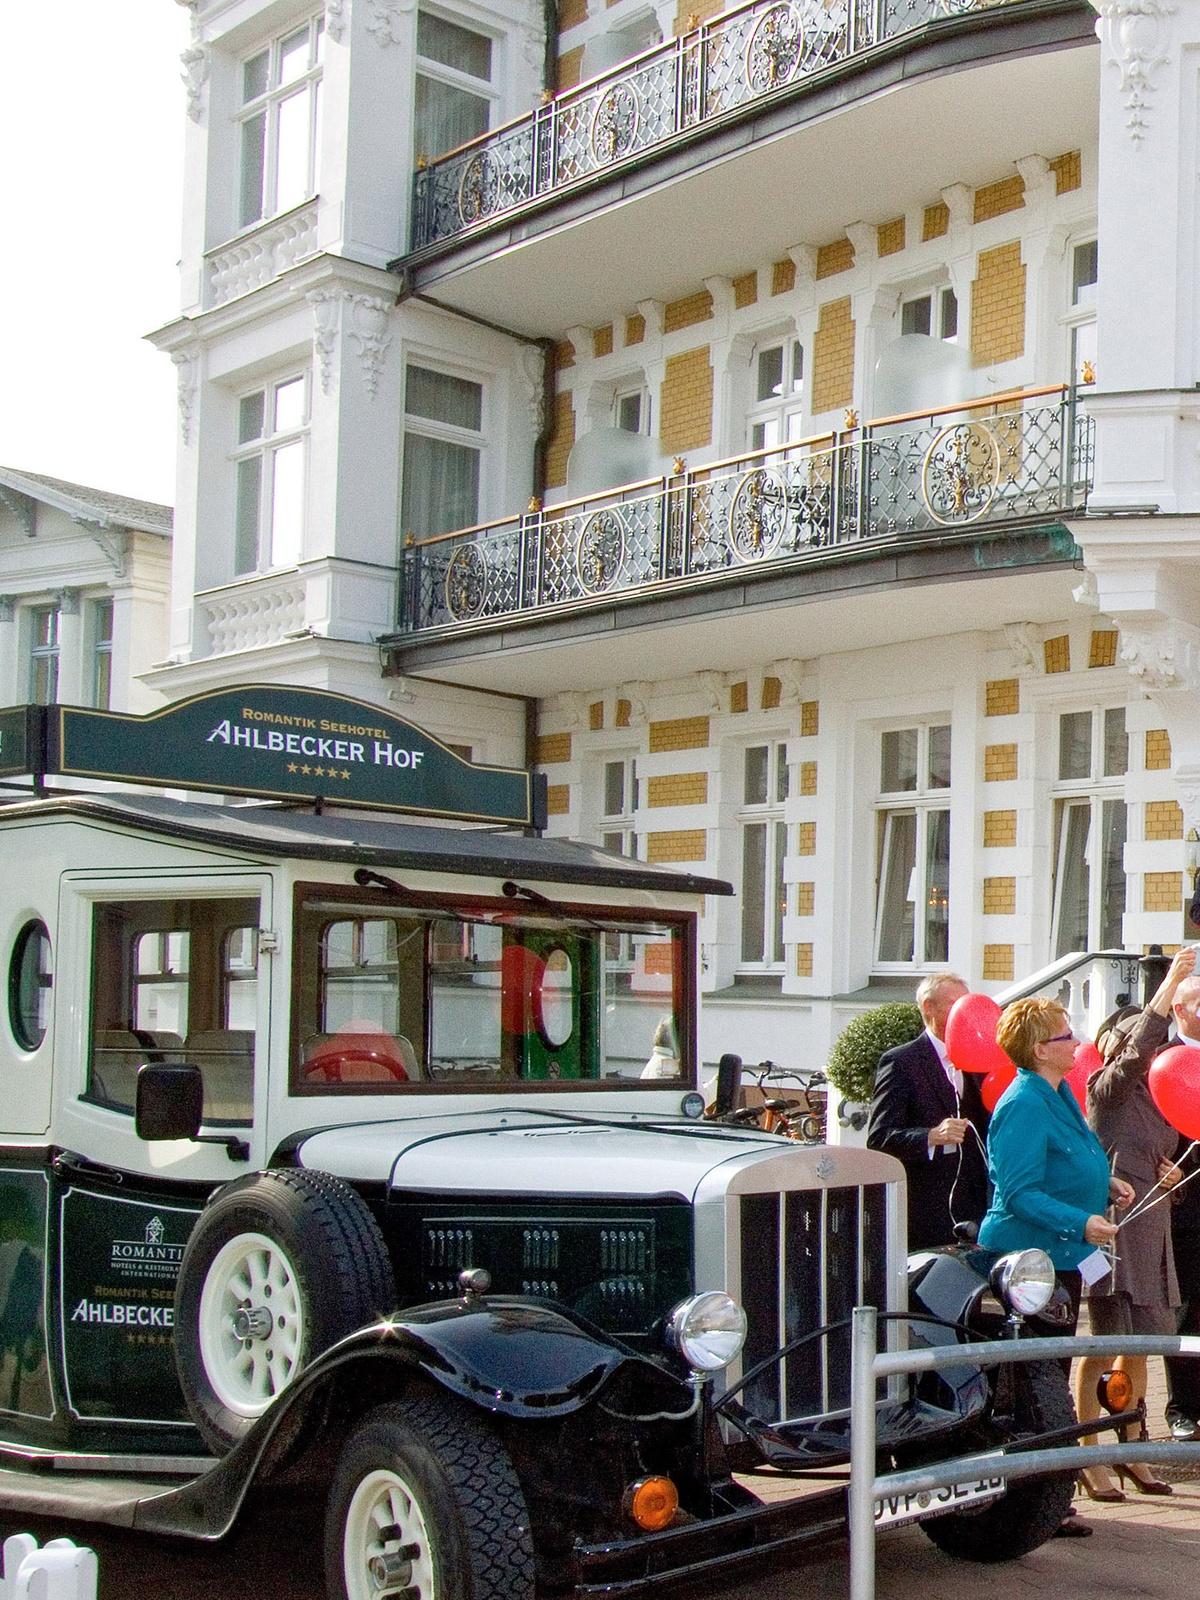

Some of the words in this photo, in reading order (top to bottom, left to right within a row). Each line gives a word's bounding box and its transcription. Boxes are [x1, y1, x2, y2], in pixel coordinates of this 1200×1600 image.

[242, 708, 316, 729] ROMANTIK
[319, 719, 390, 739] SEEHOTEL
[206, 719, 365, 763] AHLBECKER
[373, 740, 425, 770] HOF
[111, 1261, 137, 1270] HOTELS
[144, 1264, 180, 1272] RESTAURA
[112, 1245, 182, 1260] ROMANTI
[70, 1298, 175, 1327] AHLBECKE
